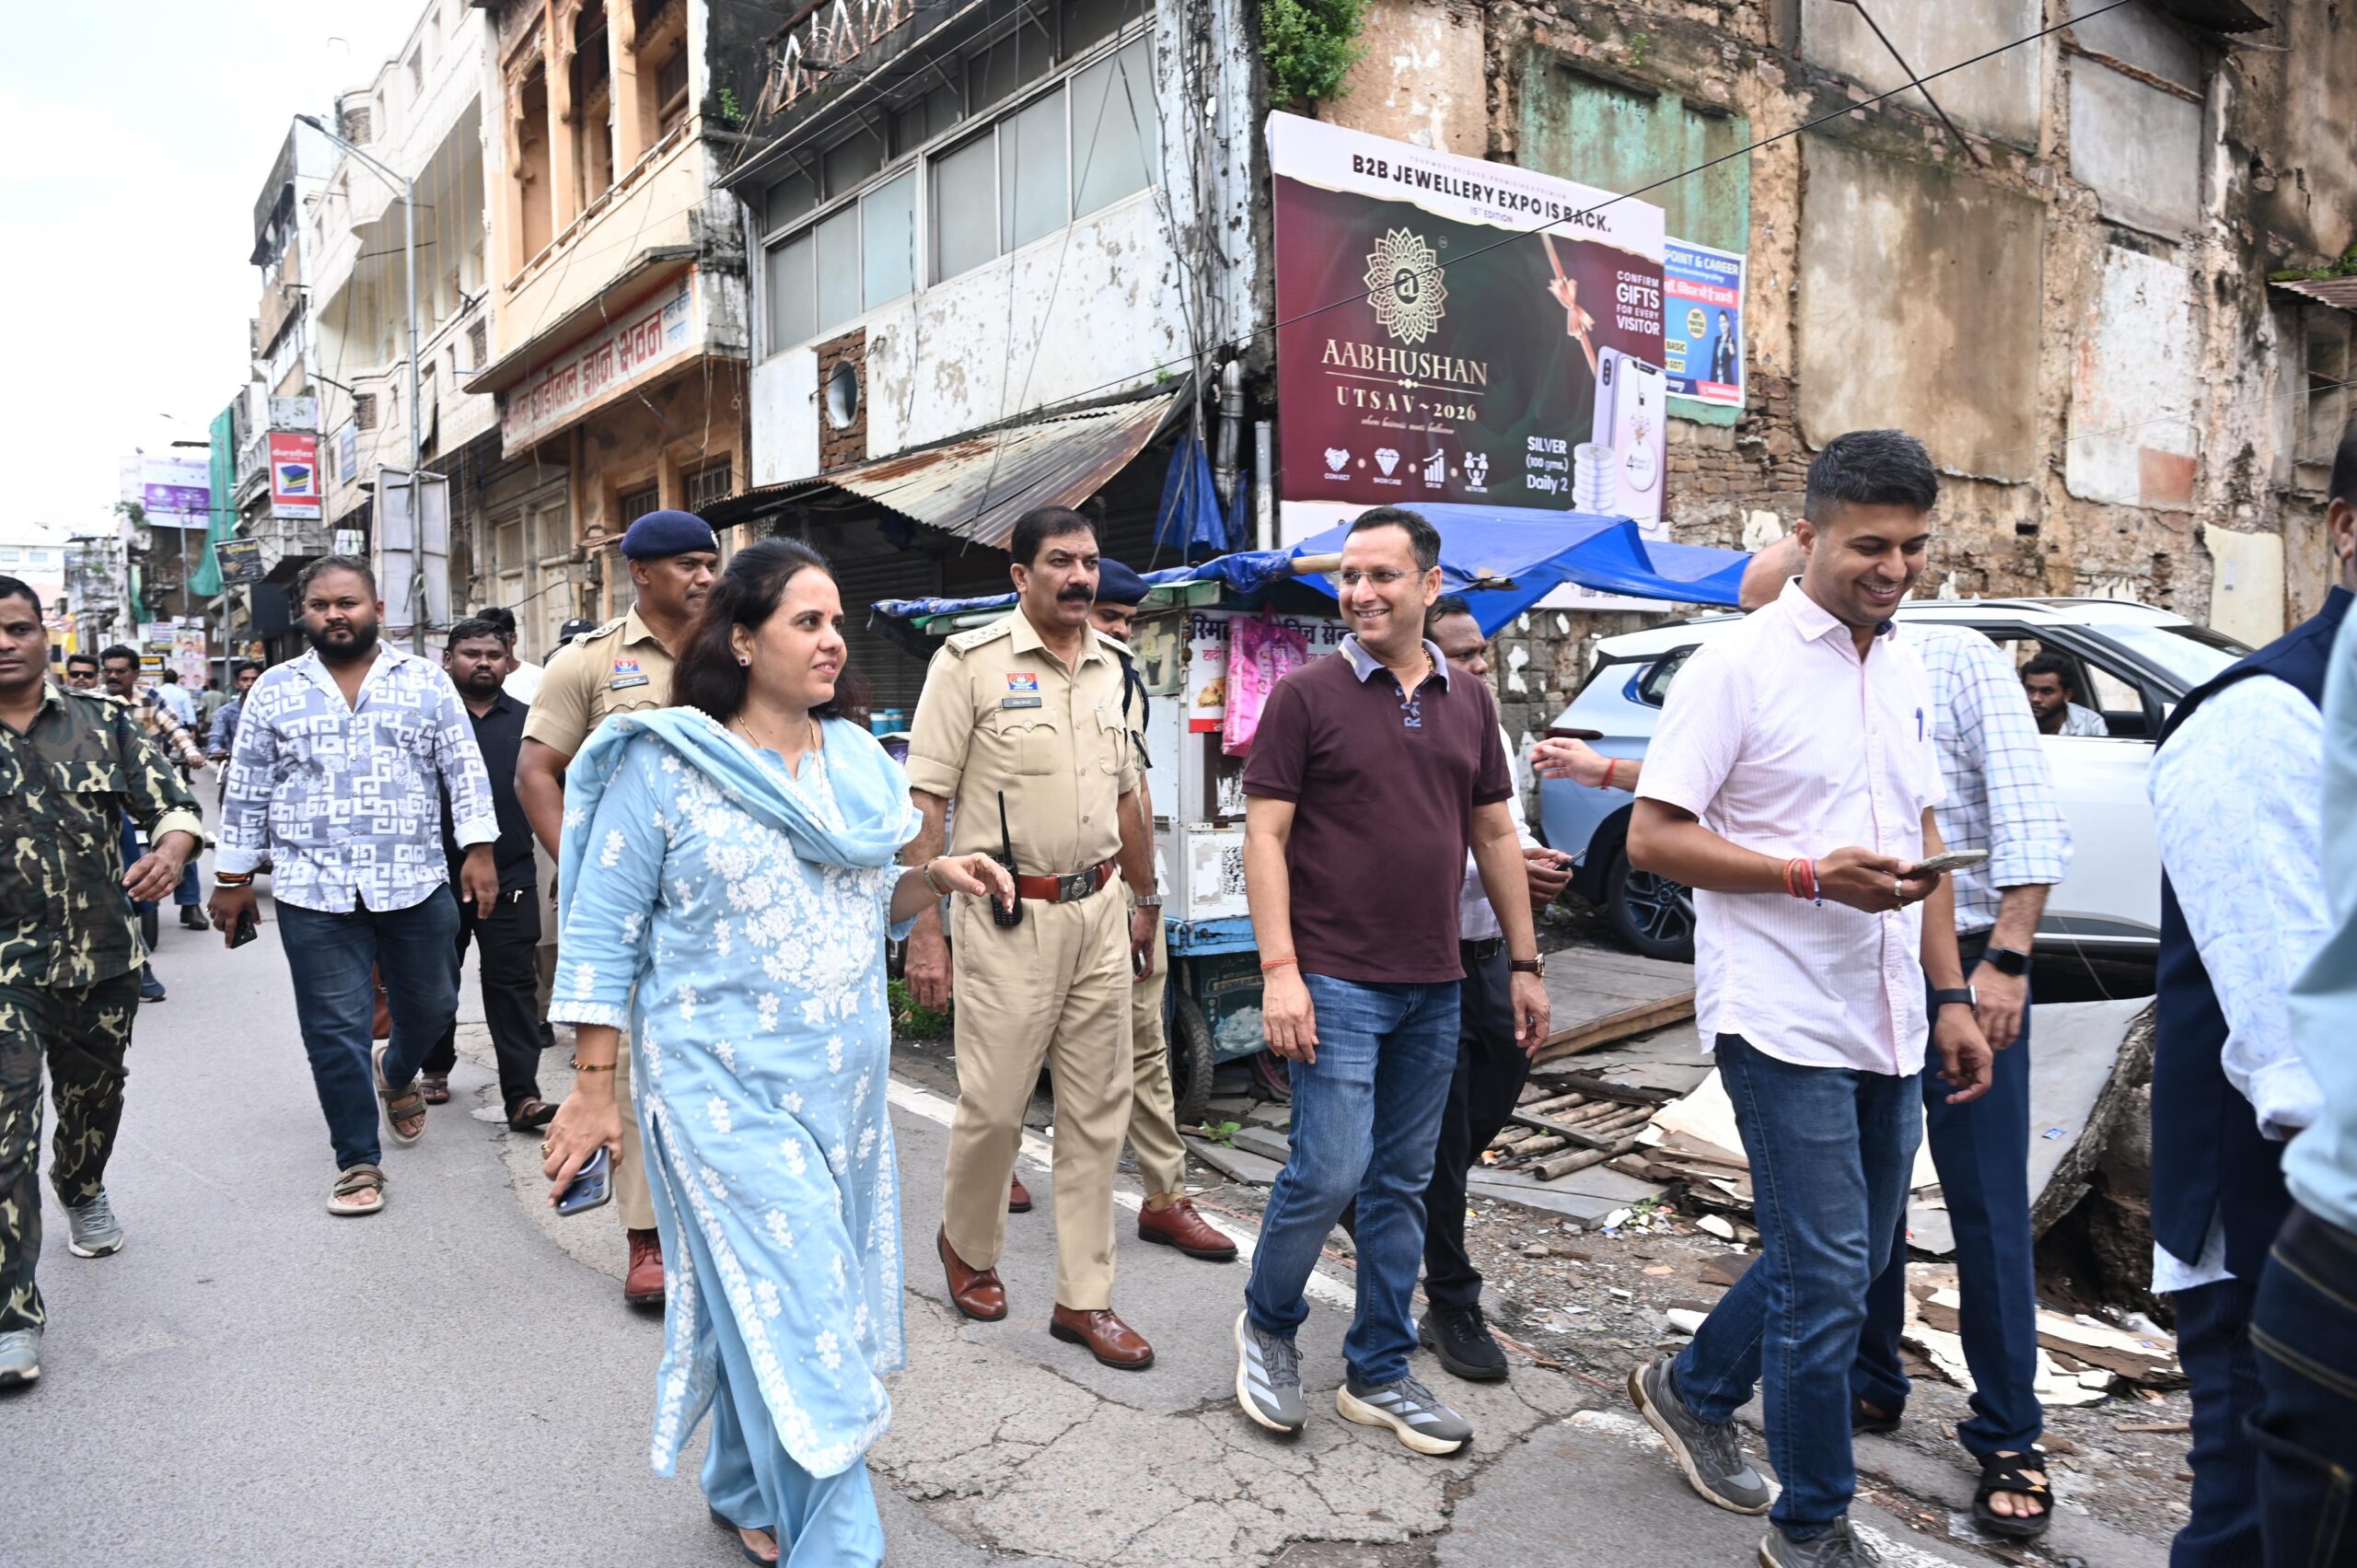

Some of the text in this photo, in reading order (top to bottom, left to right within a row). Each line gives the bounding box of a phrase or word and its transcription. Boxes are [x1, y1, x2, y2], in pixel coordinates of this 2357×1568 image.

[1353, 154, 1611, 232] B2B JEWELLERY EXPO IS BACK.
[1483, 209, 1514, 224] EDITION
[1703, 258, 1739, 276] CAREER
[1616, 271, 1659, 288] CONFIRM
[1616, 283, 1660, 309] GIFTS
[1616, 304, 1659, 320] FOR EVERY
[1616, 315, 1660, 336] VISITOR
[619, 308, 663, 373] भवन
[1666, 341, 1686, 353] BASIC
[1321, 339, 1488, 386] AABHUSHAN
[1337, 386, 1414, 412] UTSAV
[1434, 403, 1477, 422] 2026
[1527, 436, 1567, 455] SILVER
[1526, 454, 1569, 472] (100 gms.)
[1324, 472, 1351, 482] CONNECT
[1527, 474, 1569, 495] Daily 2
